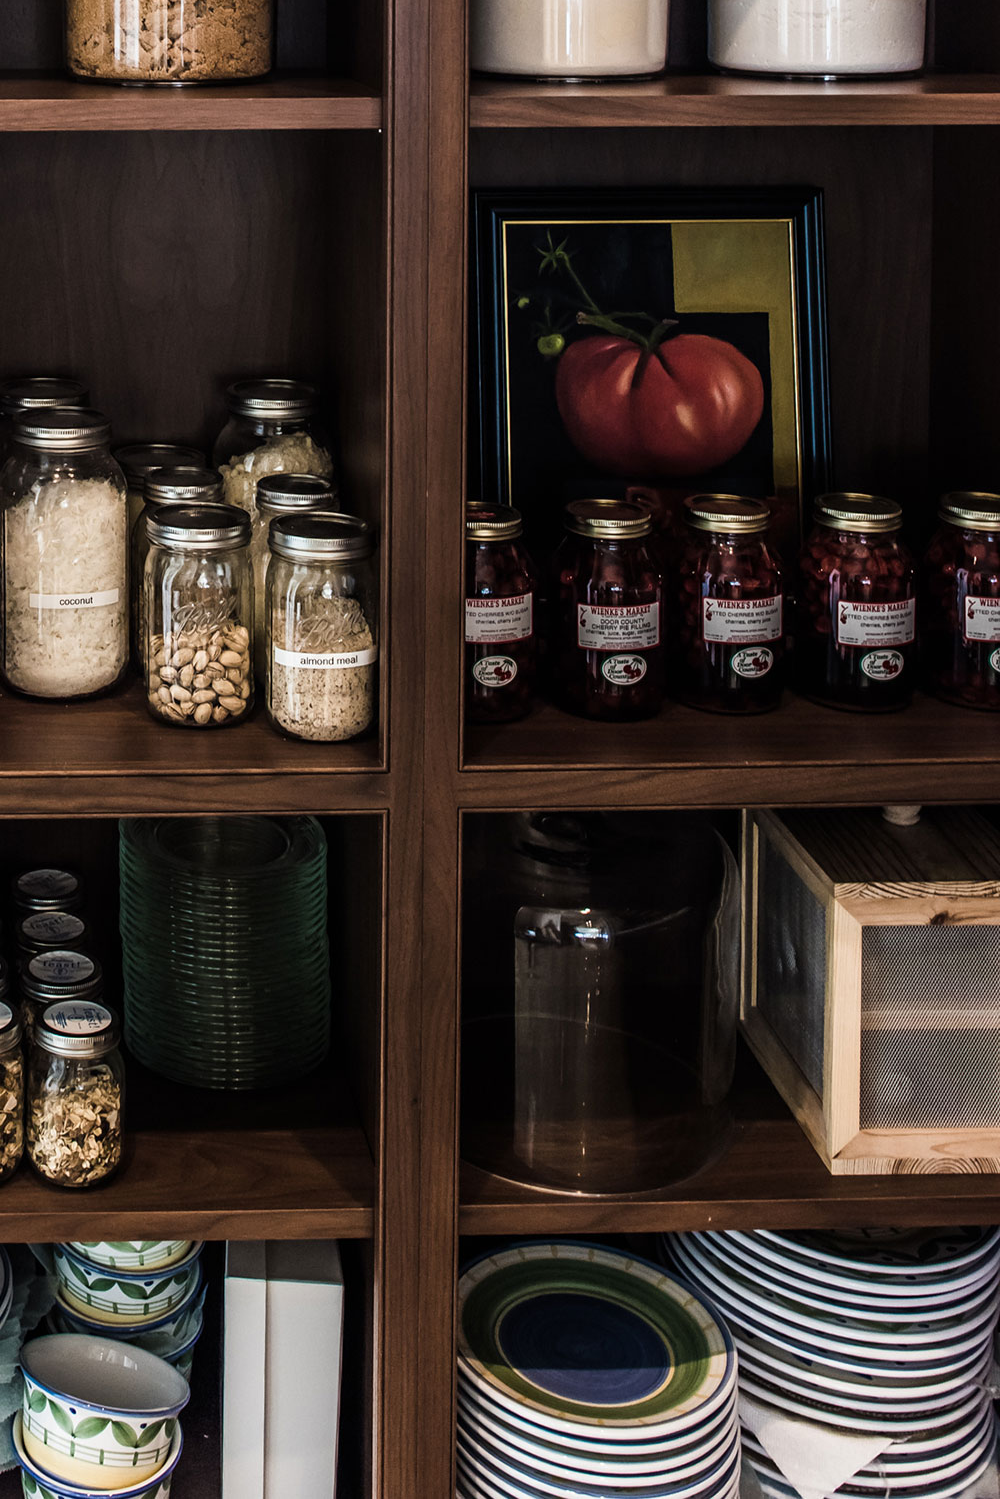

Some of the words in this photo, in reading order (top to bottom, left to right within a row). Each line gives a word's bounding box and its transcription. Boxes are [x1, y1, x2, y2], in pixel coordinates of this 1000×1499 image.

[60, 597, 93, 605] coconut
[466, 600, 500, 608] WIENKE'S
[501, 597, 525, 607] MARKET
[717, 600, 750, 609] WIENKE'S
[980, 599, 999, 607] WIEN
[590, 607, 624, 616] WIENKE'S
[626, 606, 650, 615] MARKET
[852, 604, 886, 612] WIENKE'S
[300, 657, 334, 665] almond
[337, 655, 358, 664] meal
[43, 960, 80, 968] feast!
